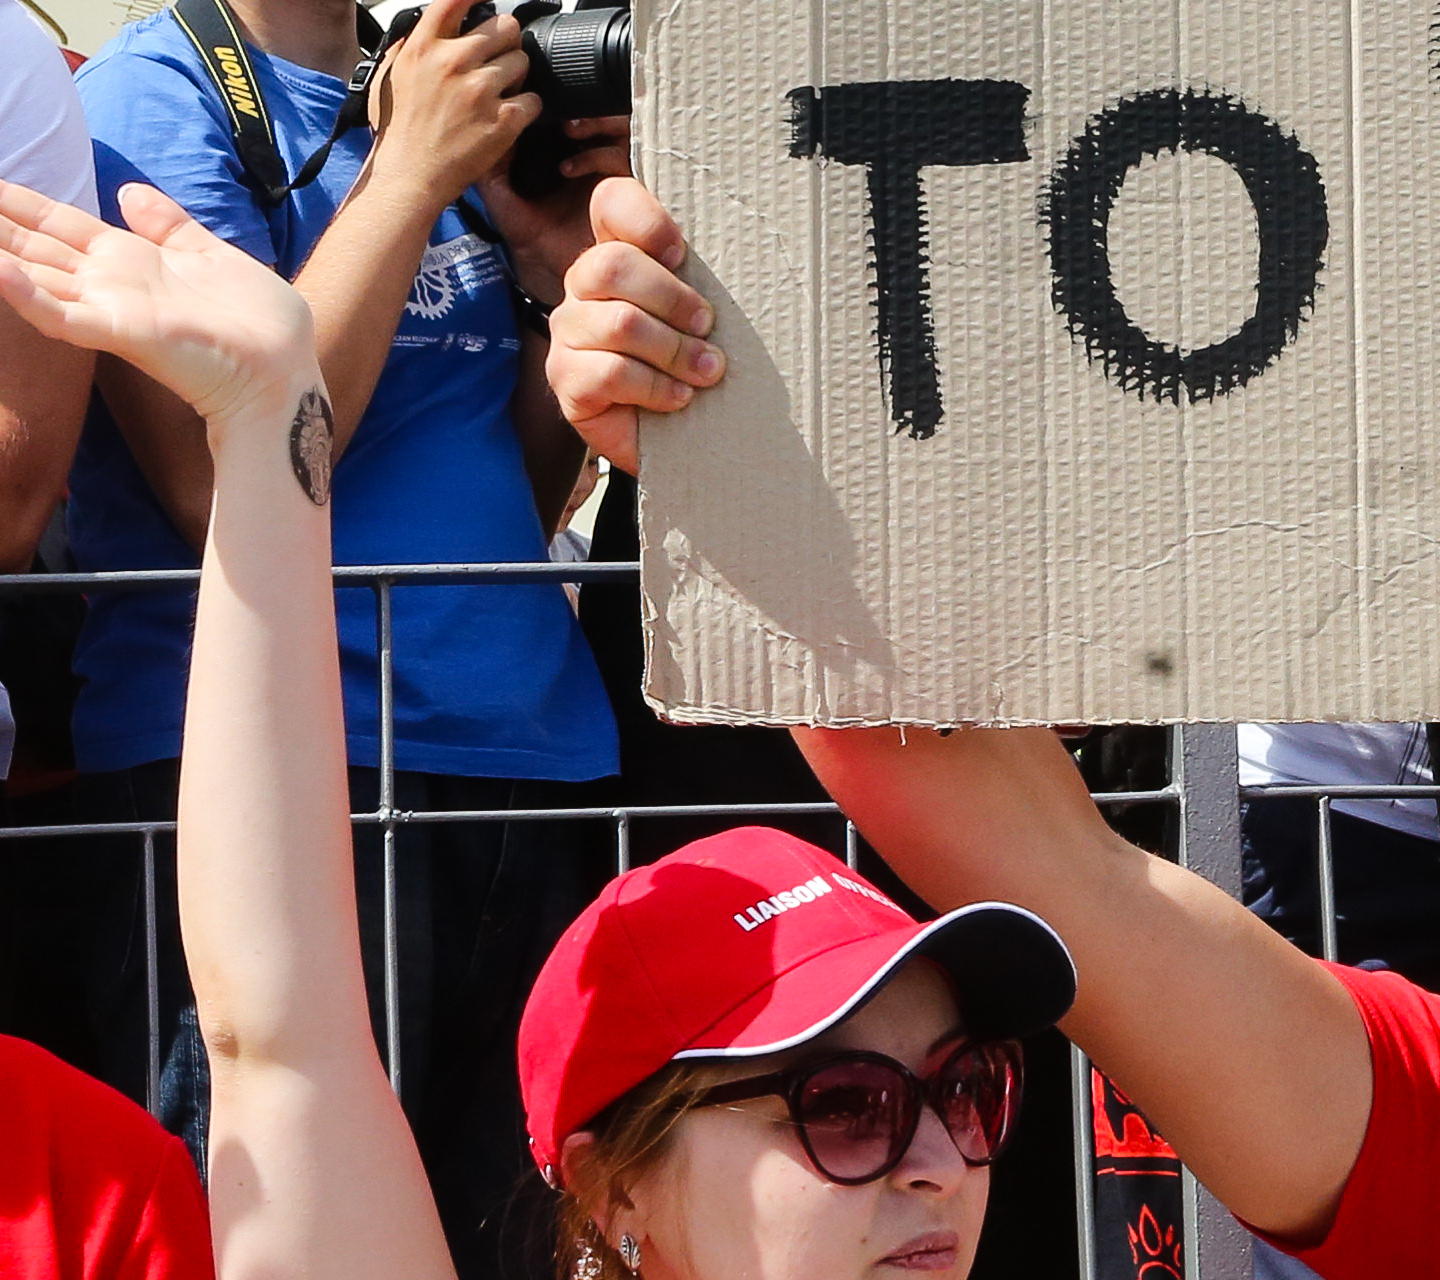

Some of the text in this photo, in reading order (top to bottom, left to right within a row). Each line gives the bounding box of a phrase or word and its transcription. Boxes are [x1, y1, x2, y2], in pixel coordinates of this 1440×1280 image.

[213, 46, 260, 119] Nikon
[786, 77, 1329, 442] TO
[733, 875, 833, 932] LIAISON
